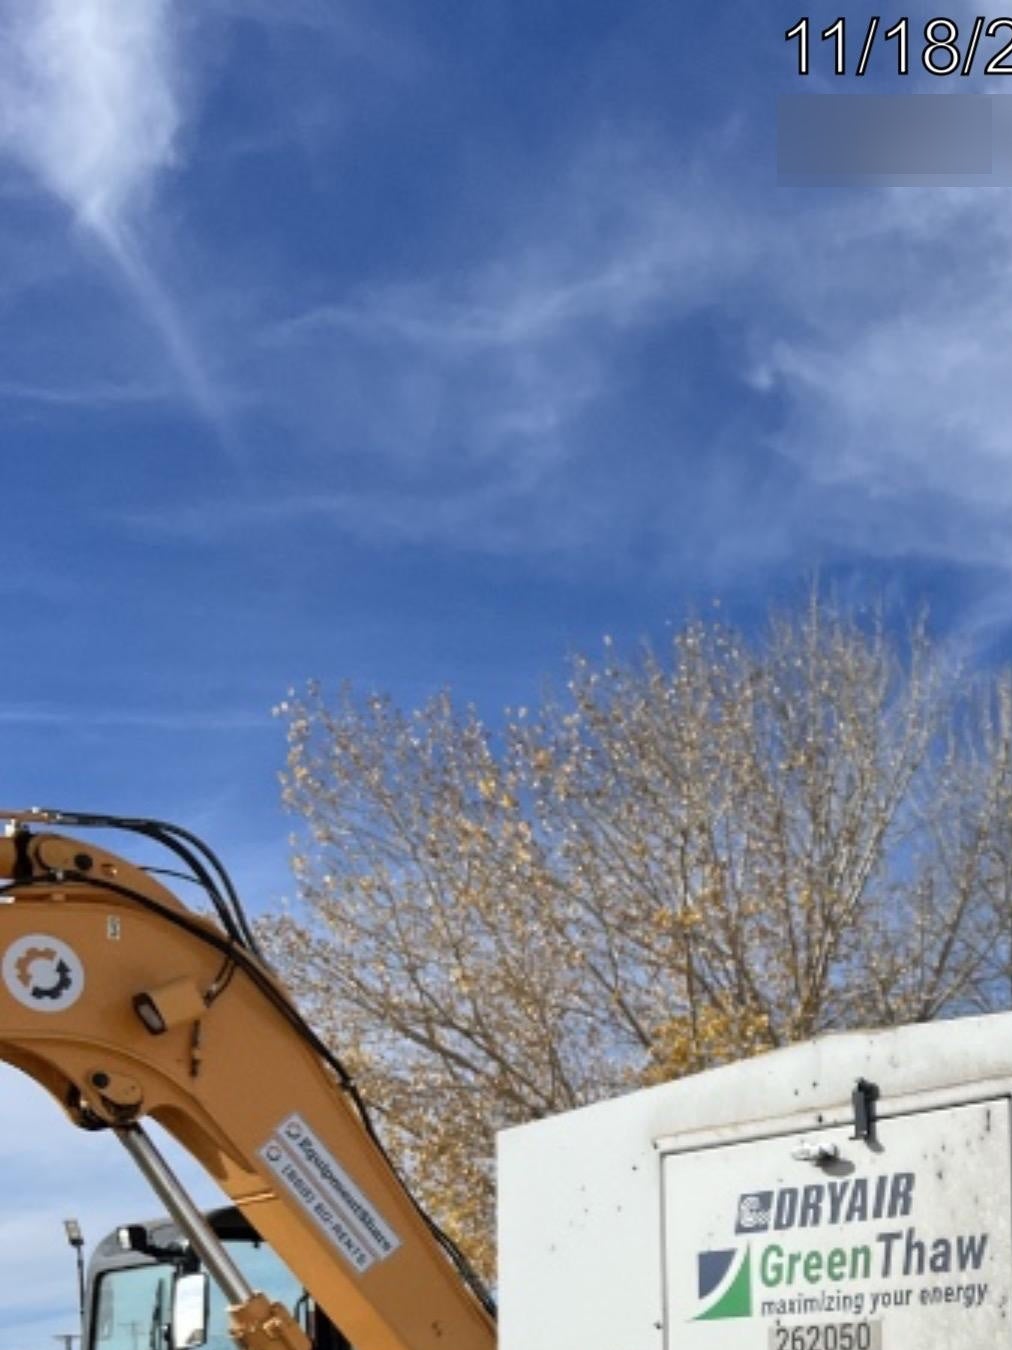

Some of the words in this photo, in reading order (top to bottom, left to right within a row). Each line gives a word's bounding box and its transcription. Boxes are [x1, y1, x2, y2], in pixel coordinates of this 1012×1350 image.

[772, 1172, 915, 1231] DRYAIR
[761, 1290, 866, 1317] maximizing
[869, 1288, 914, 1314] your
[919, 1283, 988, 1307] energy
